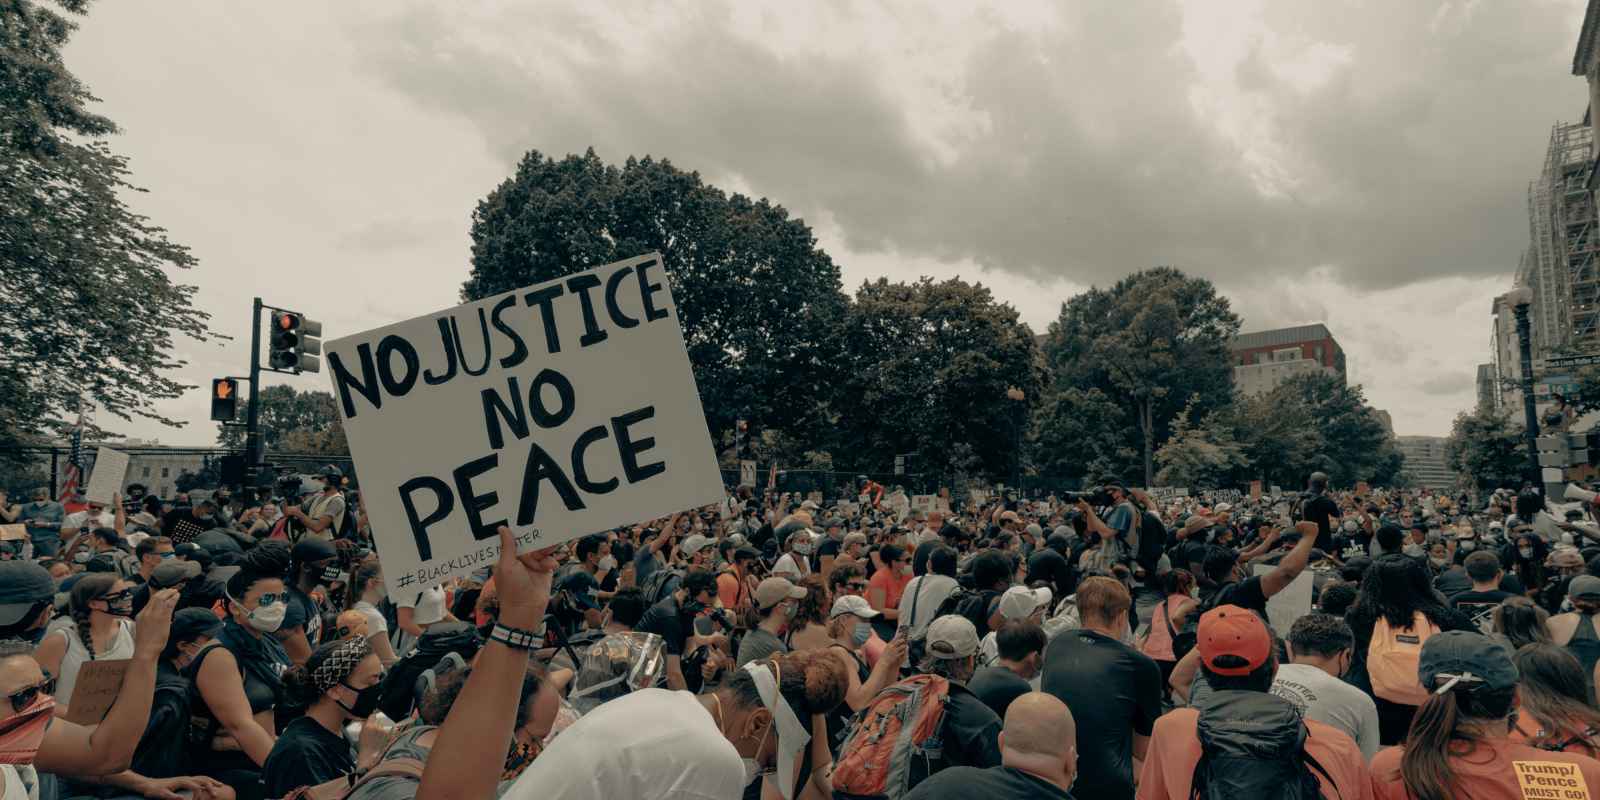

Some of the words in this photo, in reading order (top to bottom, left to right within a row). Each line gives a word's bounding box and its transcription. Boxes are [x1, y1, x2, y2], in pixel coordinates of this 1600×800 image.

[328, 334, 420, 418] NO
[424, 260, 669, 386] JUSTICE
[481, 368, 575, 449] NO
[398, 405, 666, 562] PEACE
[1516, 763, 1574, 776] Trump/
[1524, 774, 1577, 787] Pence
[1524, 787, 1560, 798] MUST
